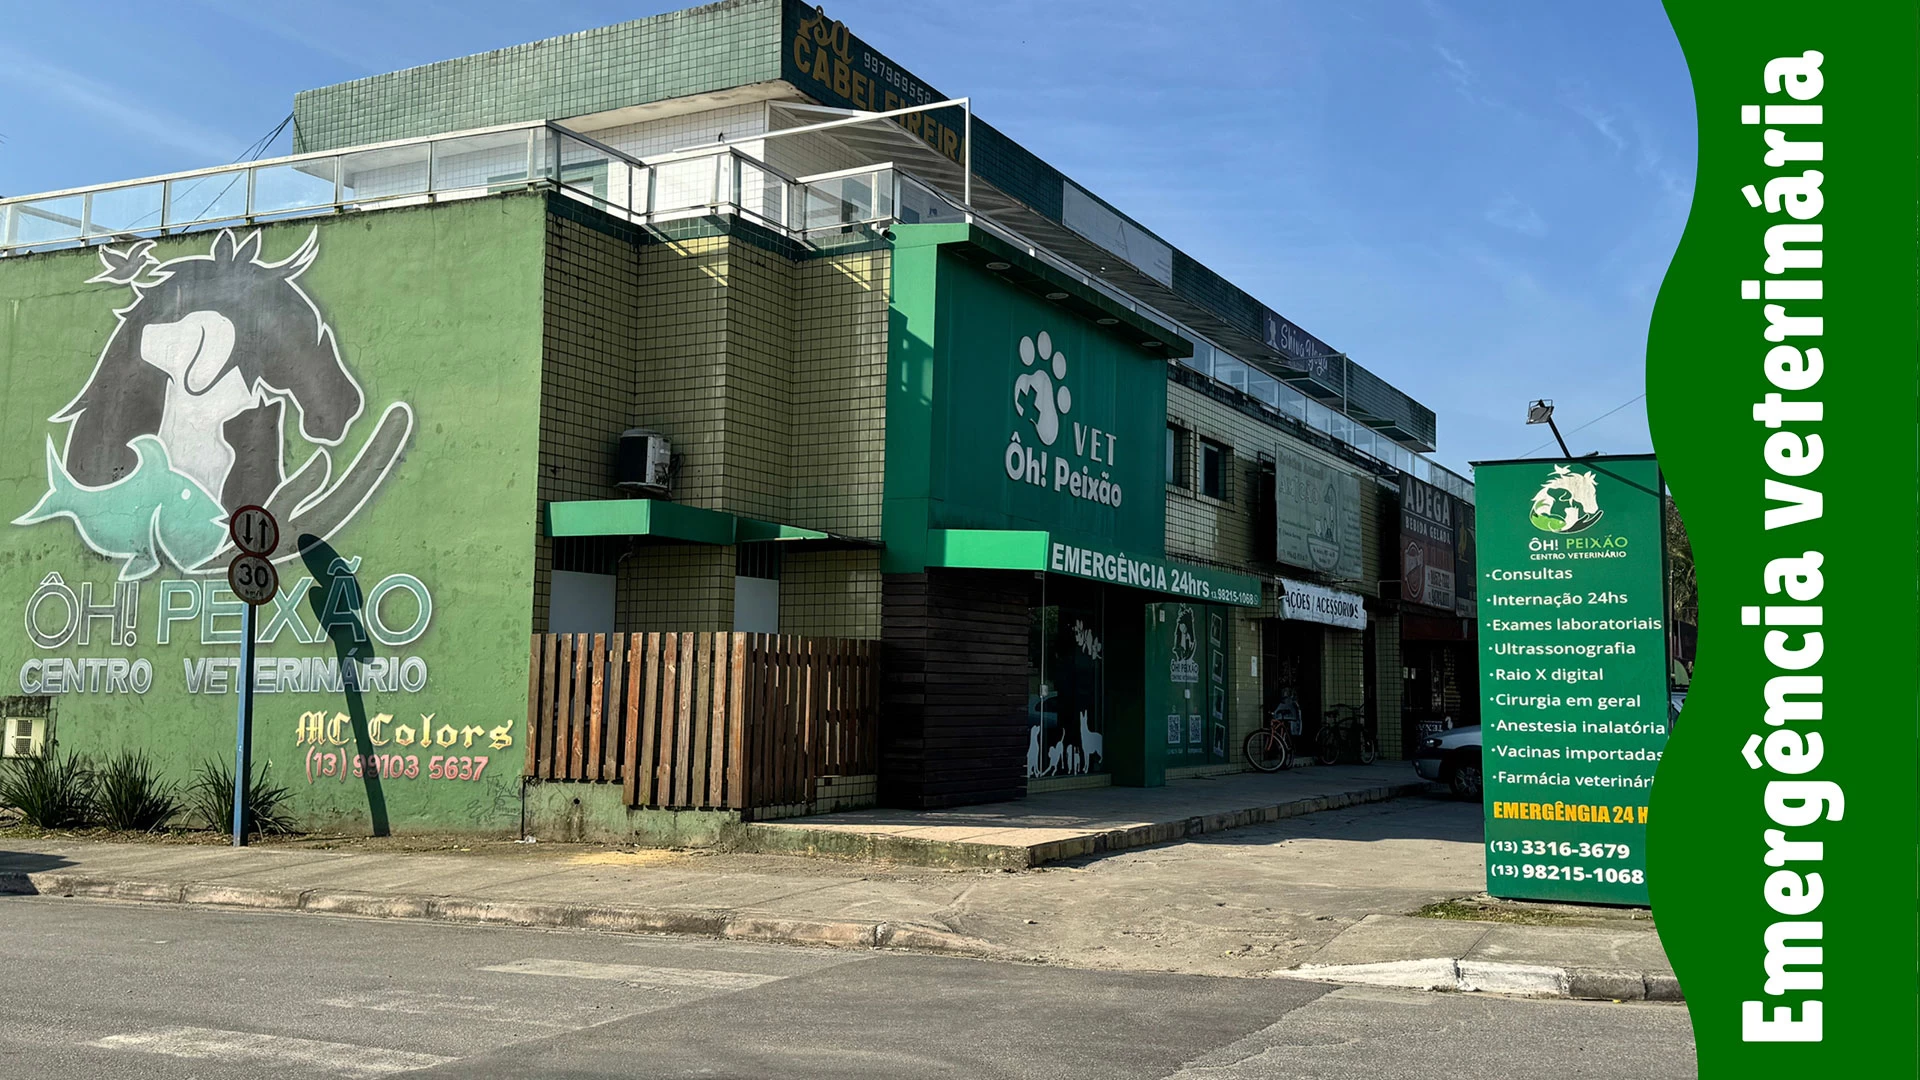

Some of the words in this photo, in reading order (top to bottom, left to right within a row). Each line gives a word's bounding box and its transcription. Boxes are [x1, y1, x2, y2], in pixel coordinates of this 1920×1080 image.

[1280, 323, 1305, 358] Shiva
[1073, 422, 1117, 466] VET
[1005, 431, 1047, 487] Ôh!
[1055, 457, 1122, 508] Peixão
[1405, 477, 1450, 526] ADEGA
[1405, 516, 1427, 536] BEBIDA
[1429, 526, 1451, 545] GELADA
[1529, 538, 1558, 550] ÔH!
[1566, 534, 1628, 549] PEIXÃO
[1530, 552, 1565, 560] CENTRO
[1568, 550, 1627, 560] VETERINÁRIO
[238, 563, 268, 588] 30
[1051, 542, 1168, 590] EMERGÊNCIA
[1171, 568, 1210, 598] 24hrs
[1491, 567, 1573, 581] Consultas
[25, 571, 138, 648] ÔH!
[157, 556, 432, 645] PEXÃO
[1316, 595, 1359, 619] ACESSÓRIOS
[1493, 592, 1583, 608] Internação
[1587, 592, 1628, 604] 24hs
[1492, 619, 1552, 631] Exames
[1557, 617, 1662, 630] laboratoriais
[1494, 641, 1636, 658] Ultrassonografia
[19, 657, 153, 694] CENTRO
[183, 649, 428, 694] VETERINÁRIO
[1495, 668, 1531, 681] Raio
[1535, 668, 1547, 681] X
[1551, 668, 1604, 684] digital
[1495, 693, 1561, 710] Cirurgia
[1566, 695, 1593, 707] em
[1597, 695, 1641, 710] geral
[368, 712, 514, 750] Colors
[1496, 719, 1577, 733] Anestesia
[1582, 721, 1665, 735] inalatória
[1496, 745, 1561, 759] Vacinas
[1565, 746, 1664, 763] importadas
[306, 745, 347, 784] (13)
[353, 754, 419, 779] 99103
[428, 755, 489, 781] 5637
[1498, 771, 1571, 786] Farmácia
[1612, 806, 1635, 824] 24
[1638, 806, 1648, 824] H
[1490, 840, 1518, 854] (13)
[1521, 840, 1630, 859] 3316-3679
[1491, 864, 1519, 877] (13)
[1522, 864, 1645, 884] 98215-1068
